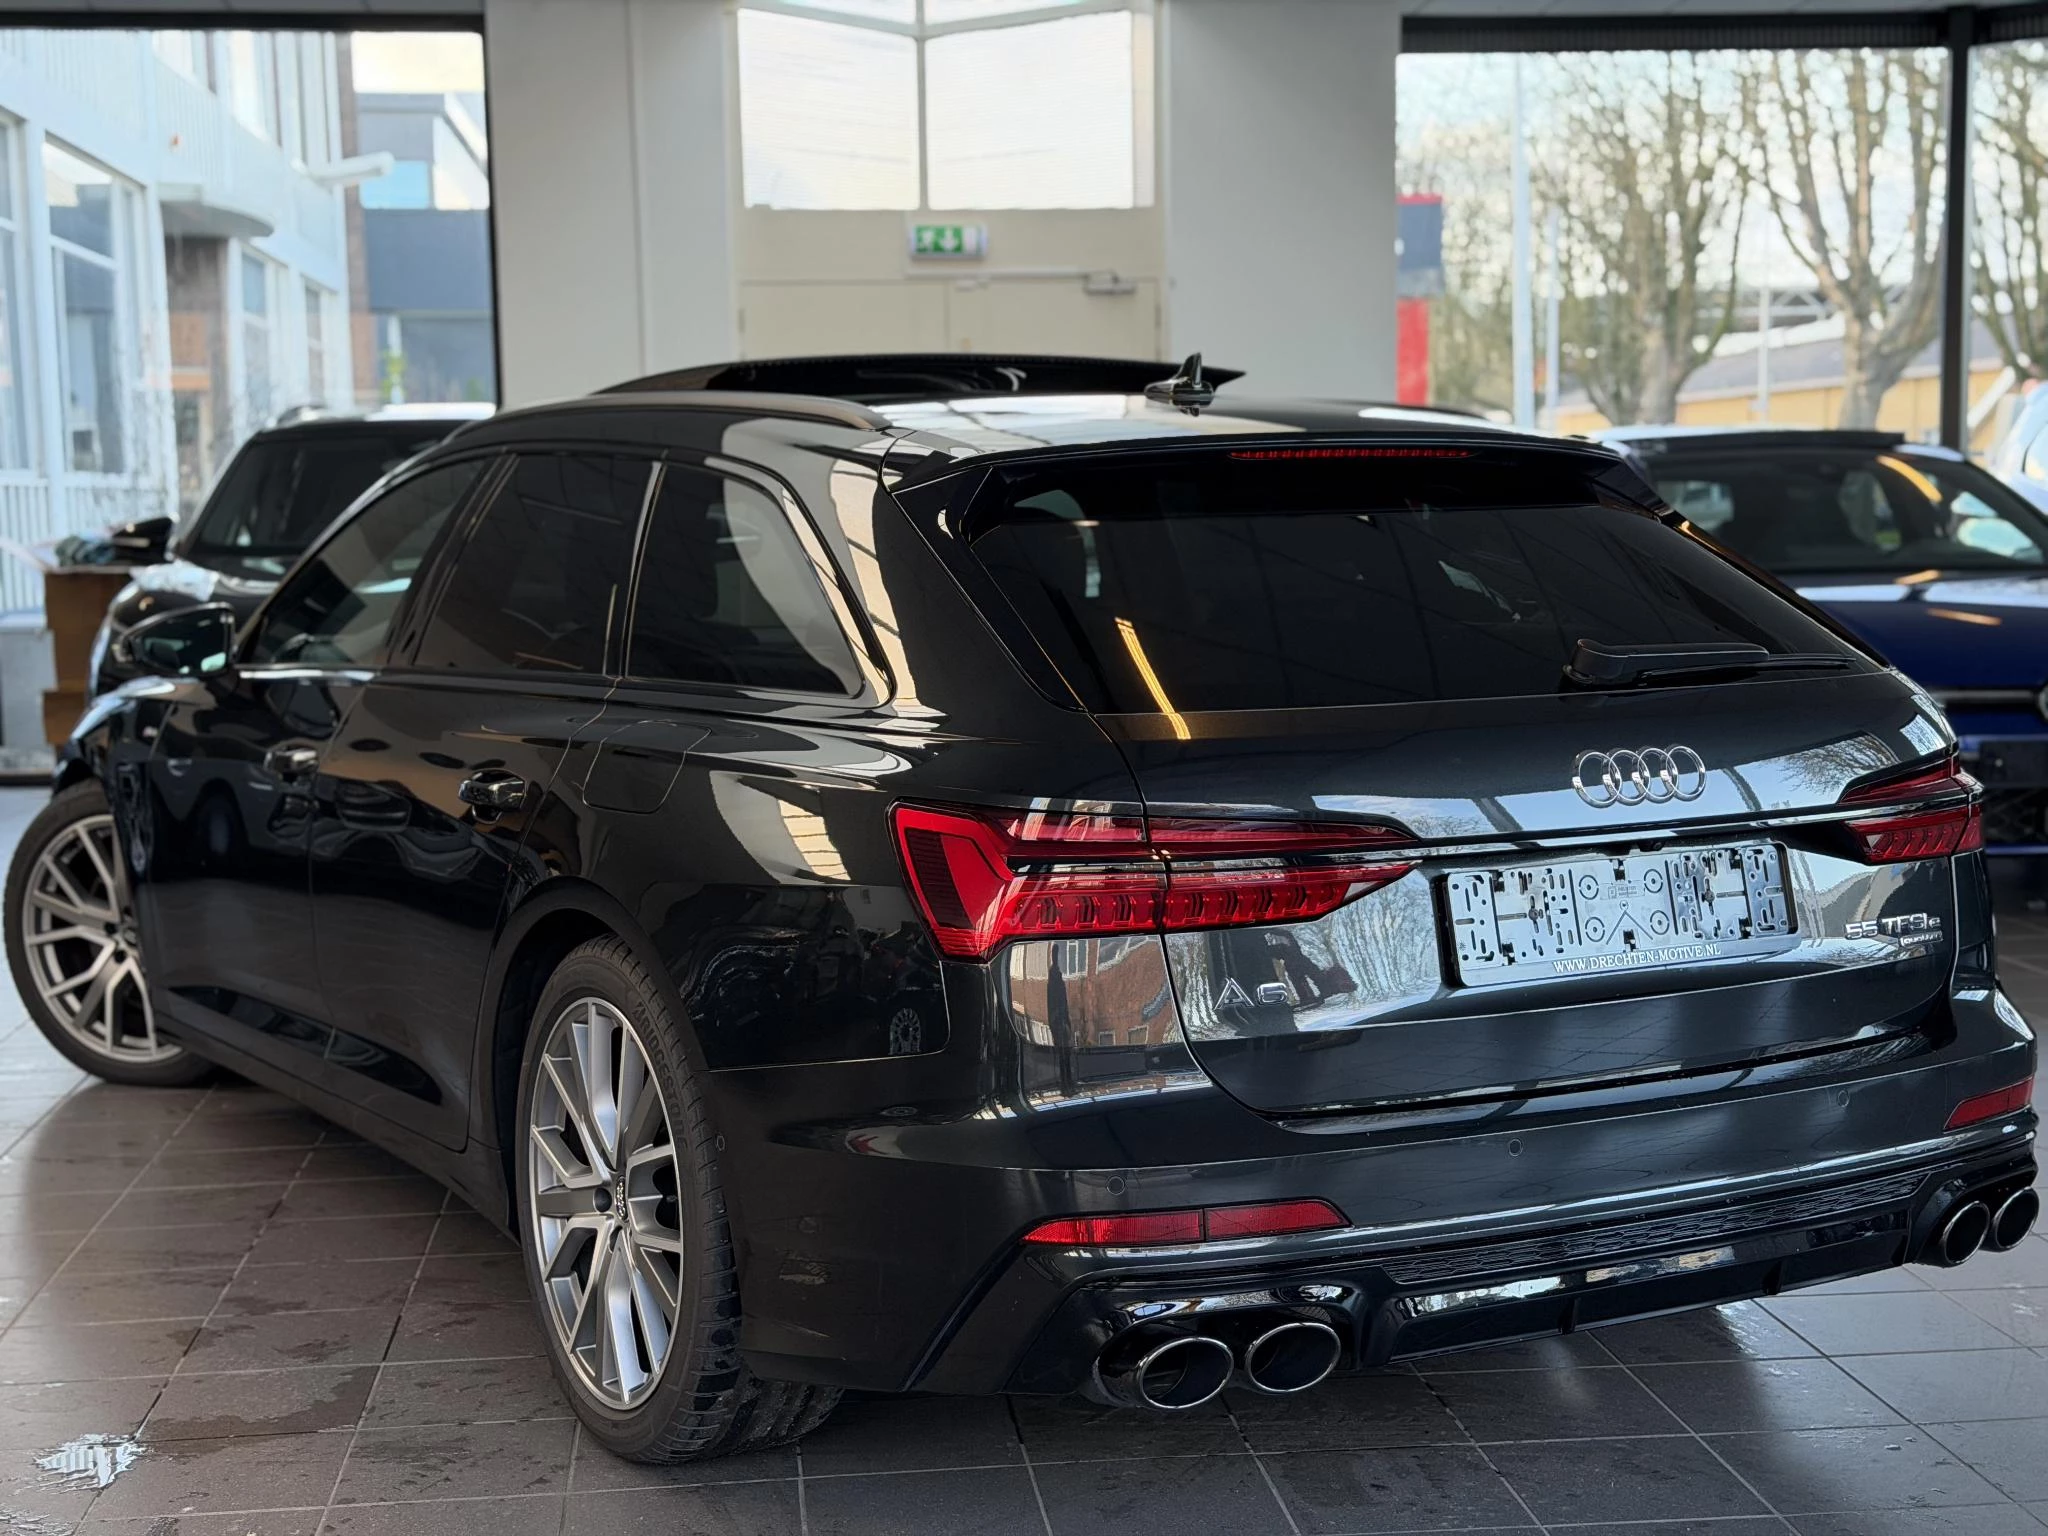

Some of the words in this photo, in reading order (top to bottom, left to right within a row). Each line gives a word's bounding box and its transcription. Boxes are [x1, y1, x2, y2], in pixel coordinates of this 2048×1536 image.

[1844, 920, 1879, 940] 55
[1553, 943, 1722, 973] WWW.DRECHTEN-MOTIVE.NL
[1213, 977, 1288, 1010] A6
